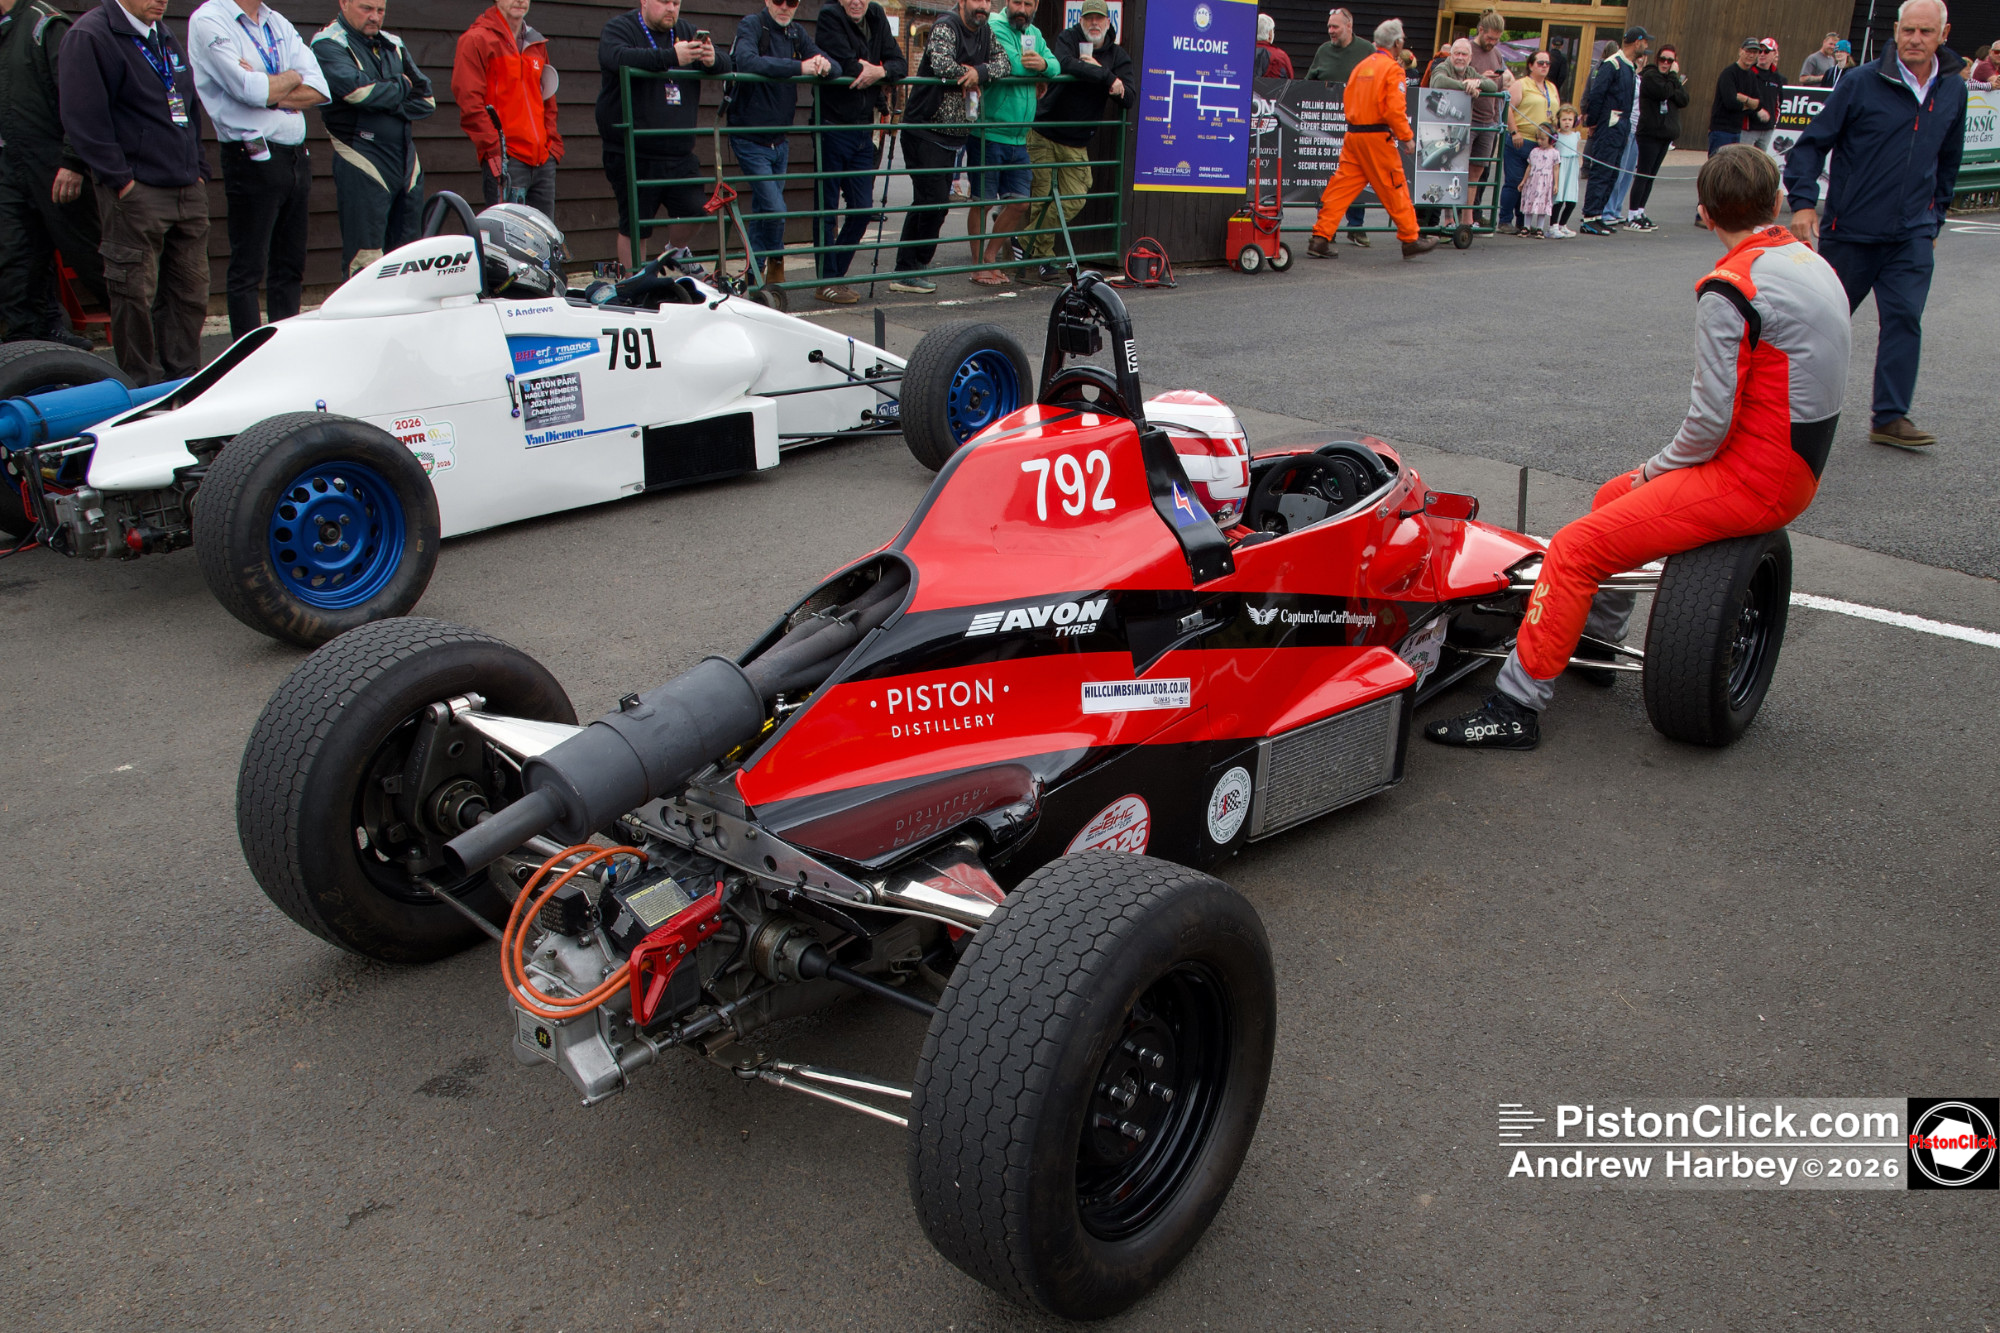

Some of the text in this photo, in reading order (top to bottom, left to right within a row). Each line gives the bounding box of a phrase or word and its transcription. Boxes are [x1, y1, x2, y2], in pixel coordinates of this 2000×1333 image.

[1172, 36, 1228, 54] WELCOME
[1302, 101, 1324, 109] ROLLING
[1326, 102, 1339, 110] ROAD
[1781, 96, 1826, 115] alfo
[1300, 112, 1346, 121] ENGINE BUILDING
[1300, 122, 1348, 132] EXPERT SERVICING
[1980, 132, 1993, 142] Cars
[1298, 161, 1317, 170] SECURE
[400, 251, 473, 276] AVON
[437, 266, 466, 276] TYRES
[515, 305, 554, 316] Andrews
[602, 328, 662, 370] 791
[531, 377, 577, 390] LOTON PARK
[525, 386, 578, 400] HAGLEY MEMBERS
[531, 395, 576, 408] 2026 Hillclimb
[532, 403, 576, 416] Championship
[395, 418, 421, 430] 2026
[525, 428, 584, 445] Van Diemen
[1021, 450, 1116, 522] 792
[1000, 599, 1108, 632] AVON
[1281, 608, 1376, 628] CaptureYourCarPhotography
[1055, 622, 1096, 637] TYRES
[888, 678, 994, 714] PISTON
[1085, 682, 1189, 698] HILLCLIMBSIMULATOR.CO.UK
[892, 713, 995, 738] DISTILLERY
